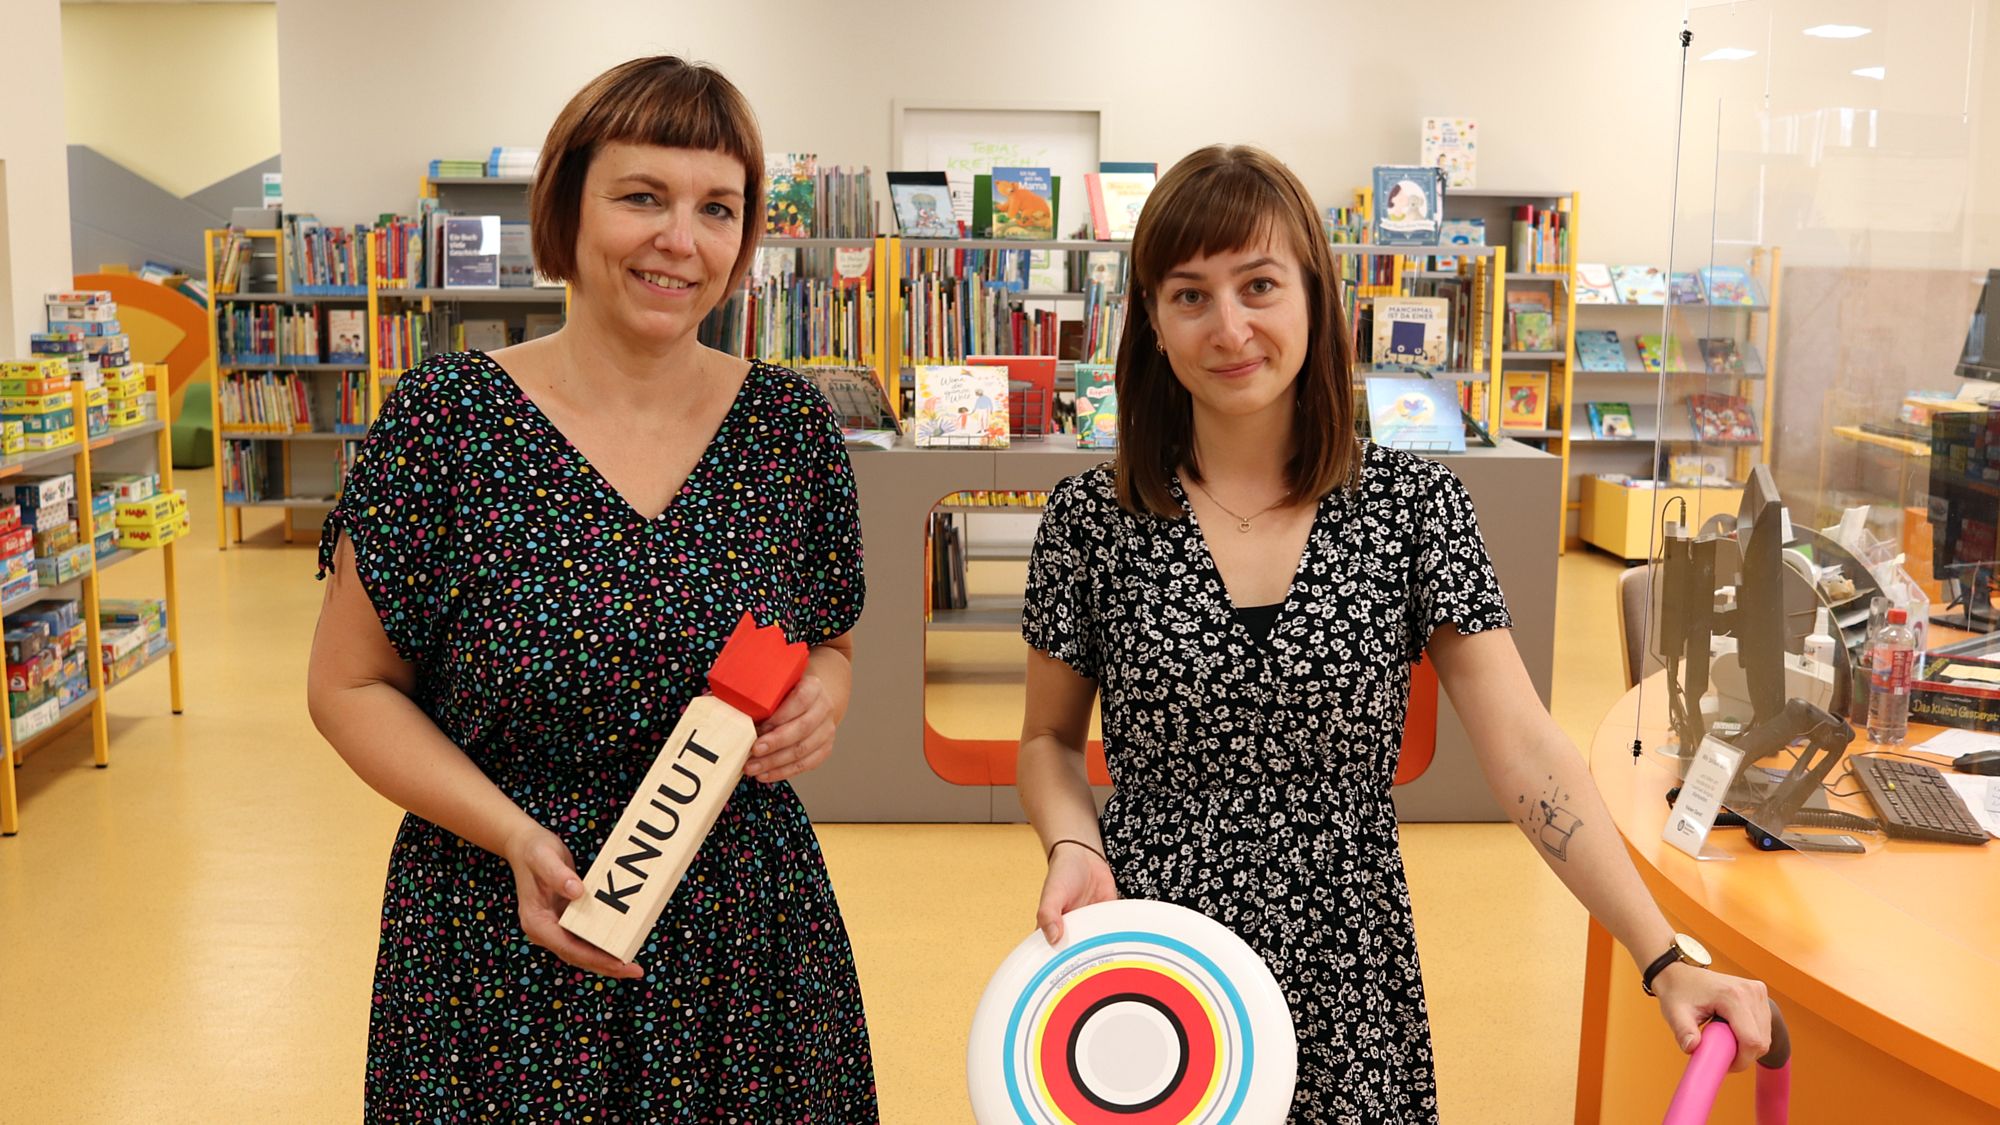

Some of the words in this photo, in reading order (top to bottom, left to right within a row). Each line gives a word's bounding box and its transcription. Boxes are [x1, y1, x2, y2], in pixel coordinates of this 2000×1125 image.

[1018, 182, 1048, 191] Mama
[1389, 306, 1433, 314] MANCHMAL
[125, 509, 147, 518] HABA
[129, 531, 151, 541] HABA
[1912, 699, 1931, 713] Das
[594, 729, 720, 915] KNUUT
